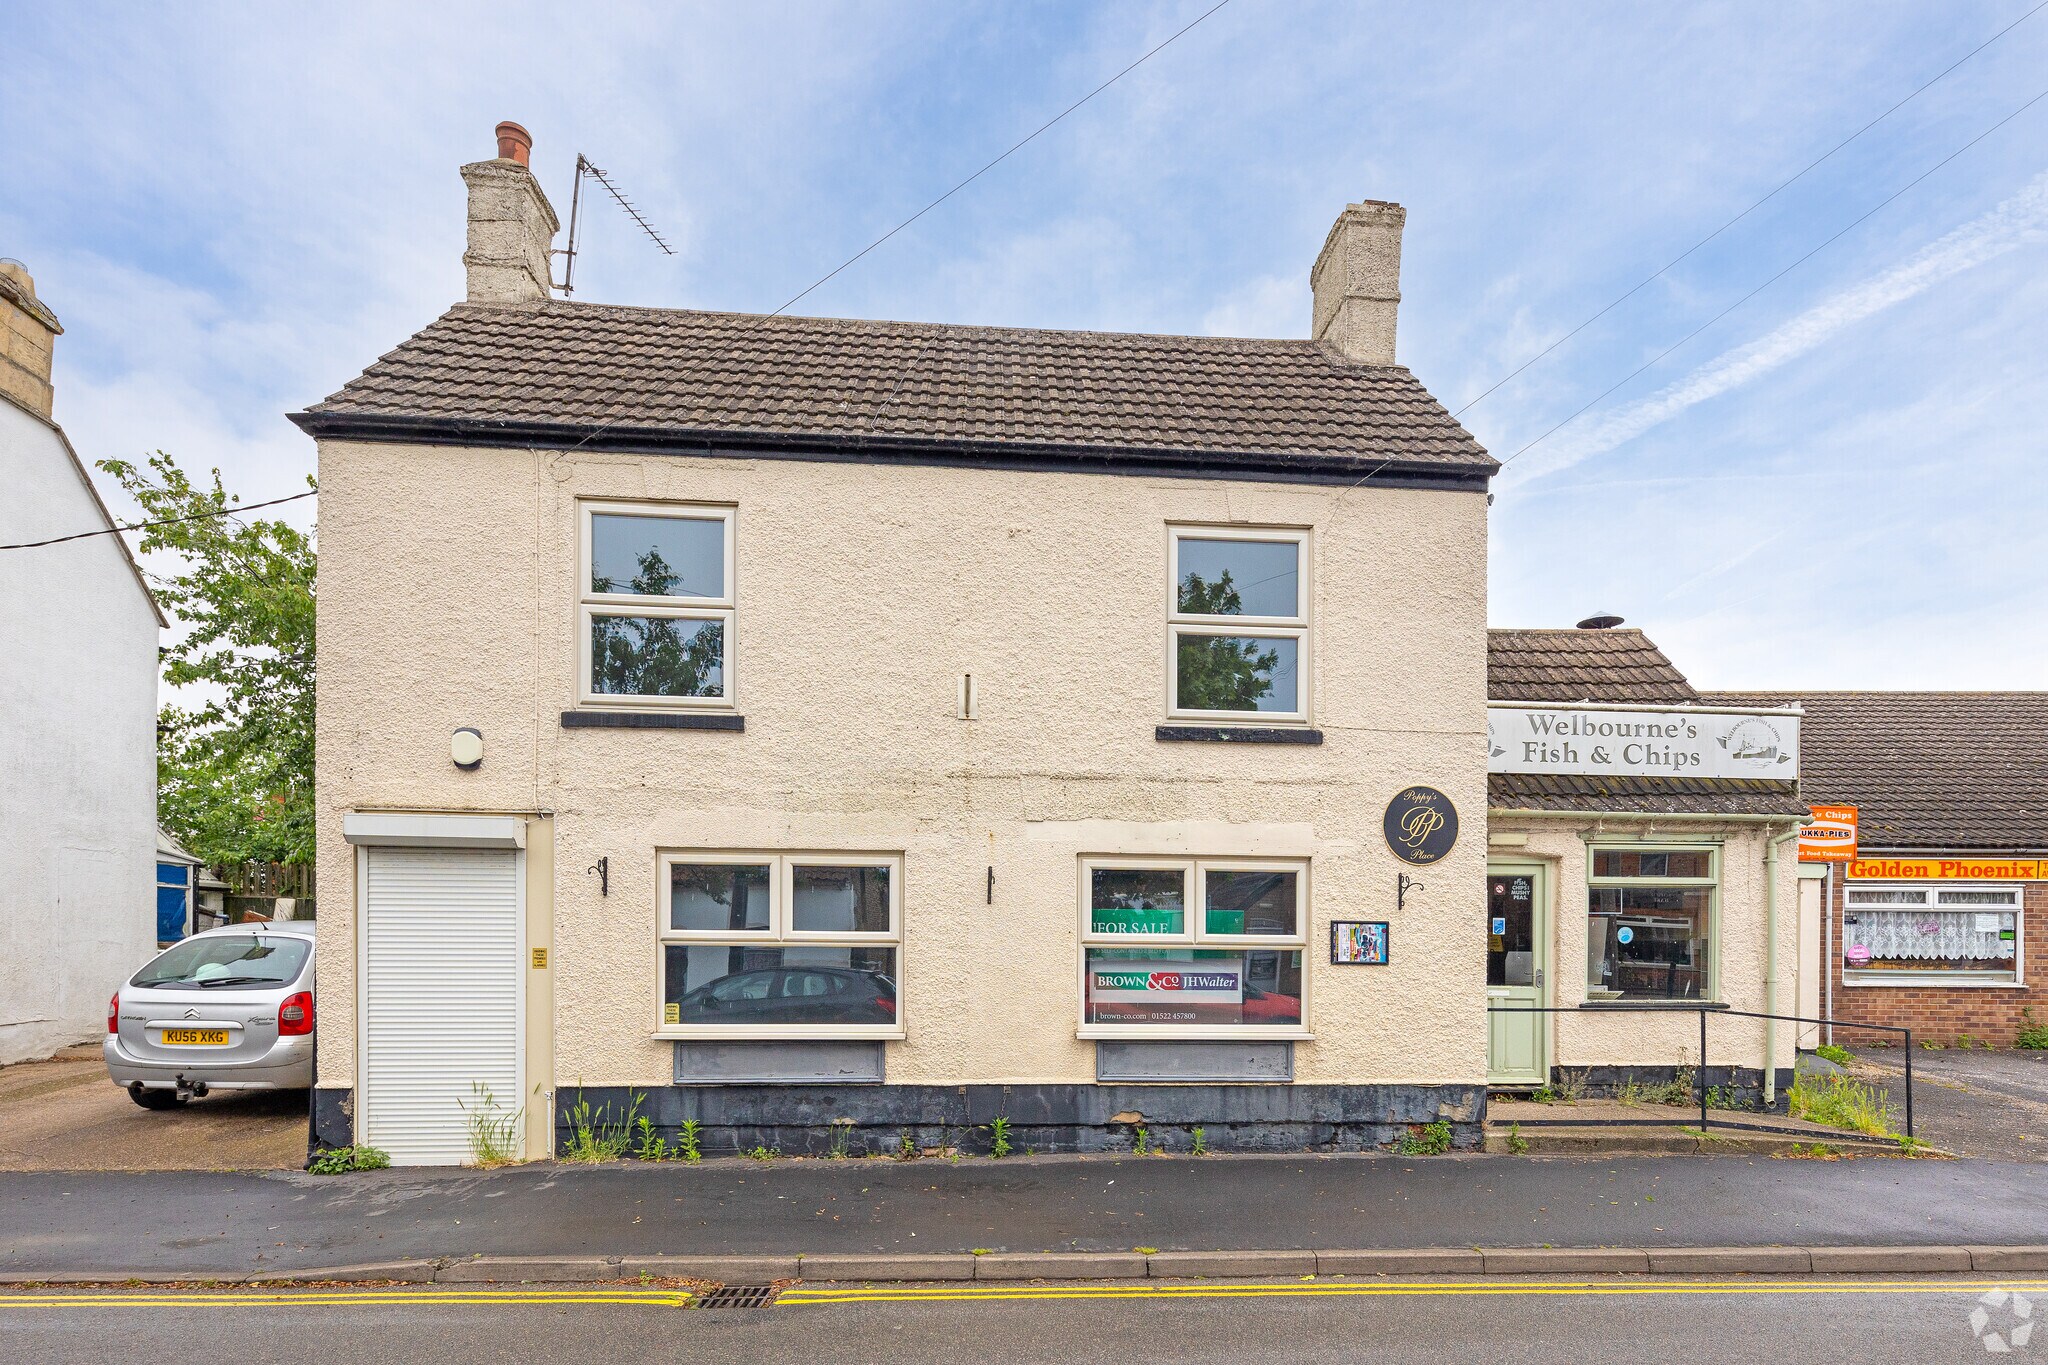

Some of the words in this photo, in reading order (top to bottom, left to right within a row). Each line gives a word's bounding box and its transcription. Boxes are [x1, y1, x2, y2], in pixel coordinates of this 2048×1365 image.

[1526, 713, 1698, 739] Welbourne's
[1522, 741, 1580, 764] Fish
[1590, 745, 1613, 765] &
[1623, 743, 1701, 771] Chips
[1403, 789, 1438, 804] Poppy's
[1825, 810, 1852, 820] Chips
[1410, 848, 1435, 860] Place
[1849, 860, 1929, 878] Golden
[1938, 860, 2034, 878] Phoenix
[1097, 922, 1127, 934] FOR
[1131, 922, 1168, 934] SALE
[1100, 1012, 1147, 1020] brown-co.com
[1151, 1012, 1171, 1020] 01522
[1172, 1012, 1196, 1020] 457800
[167, 1031, 197, 1042] KU56
[200, 1031, 224, 1043] XKG
